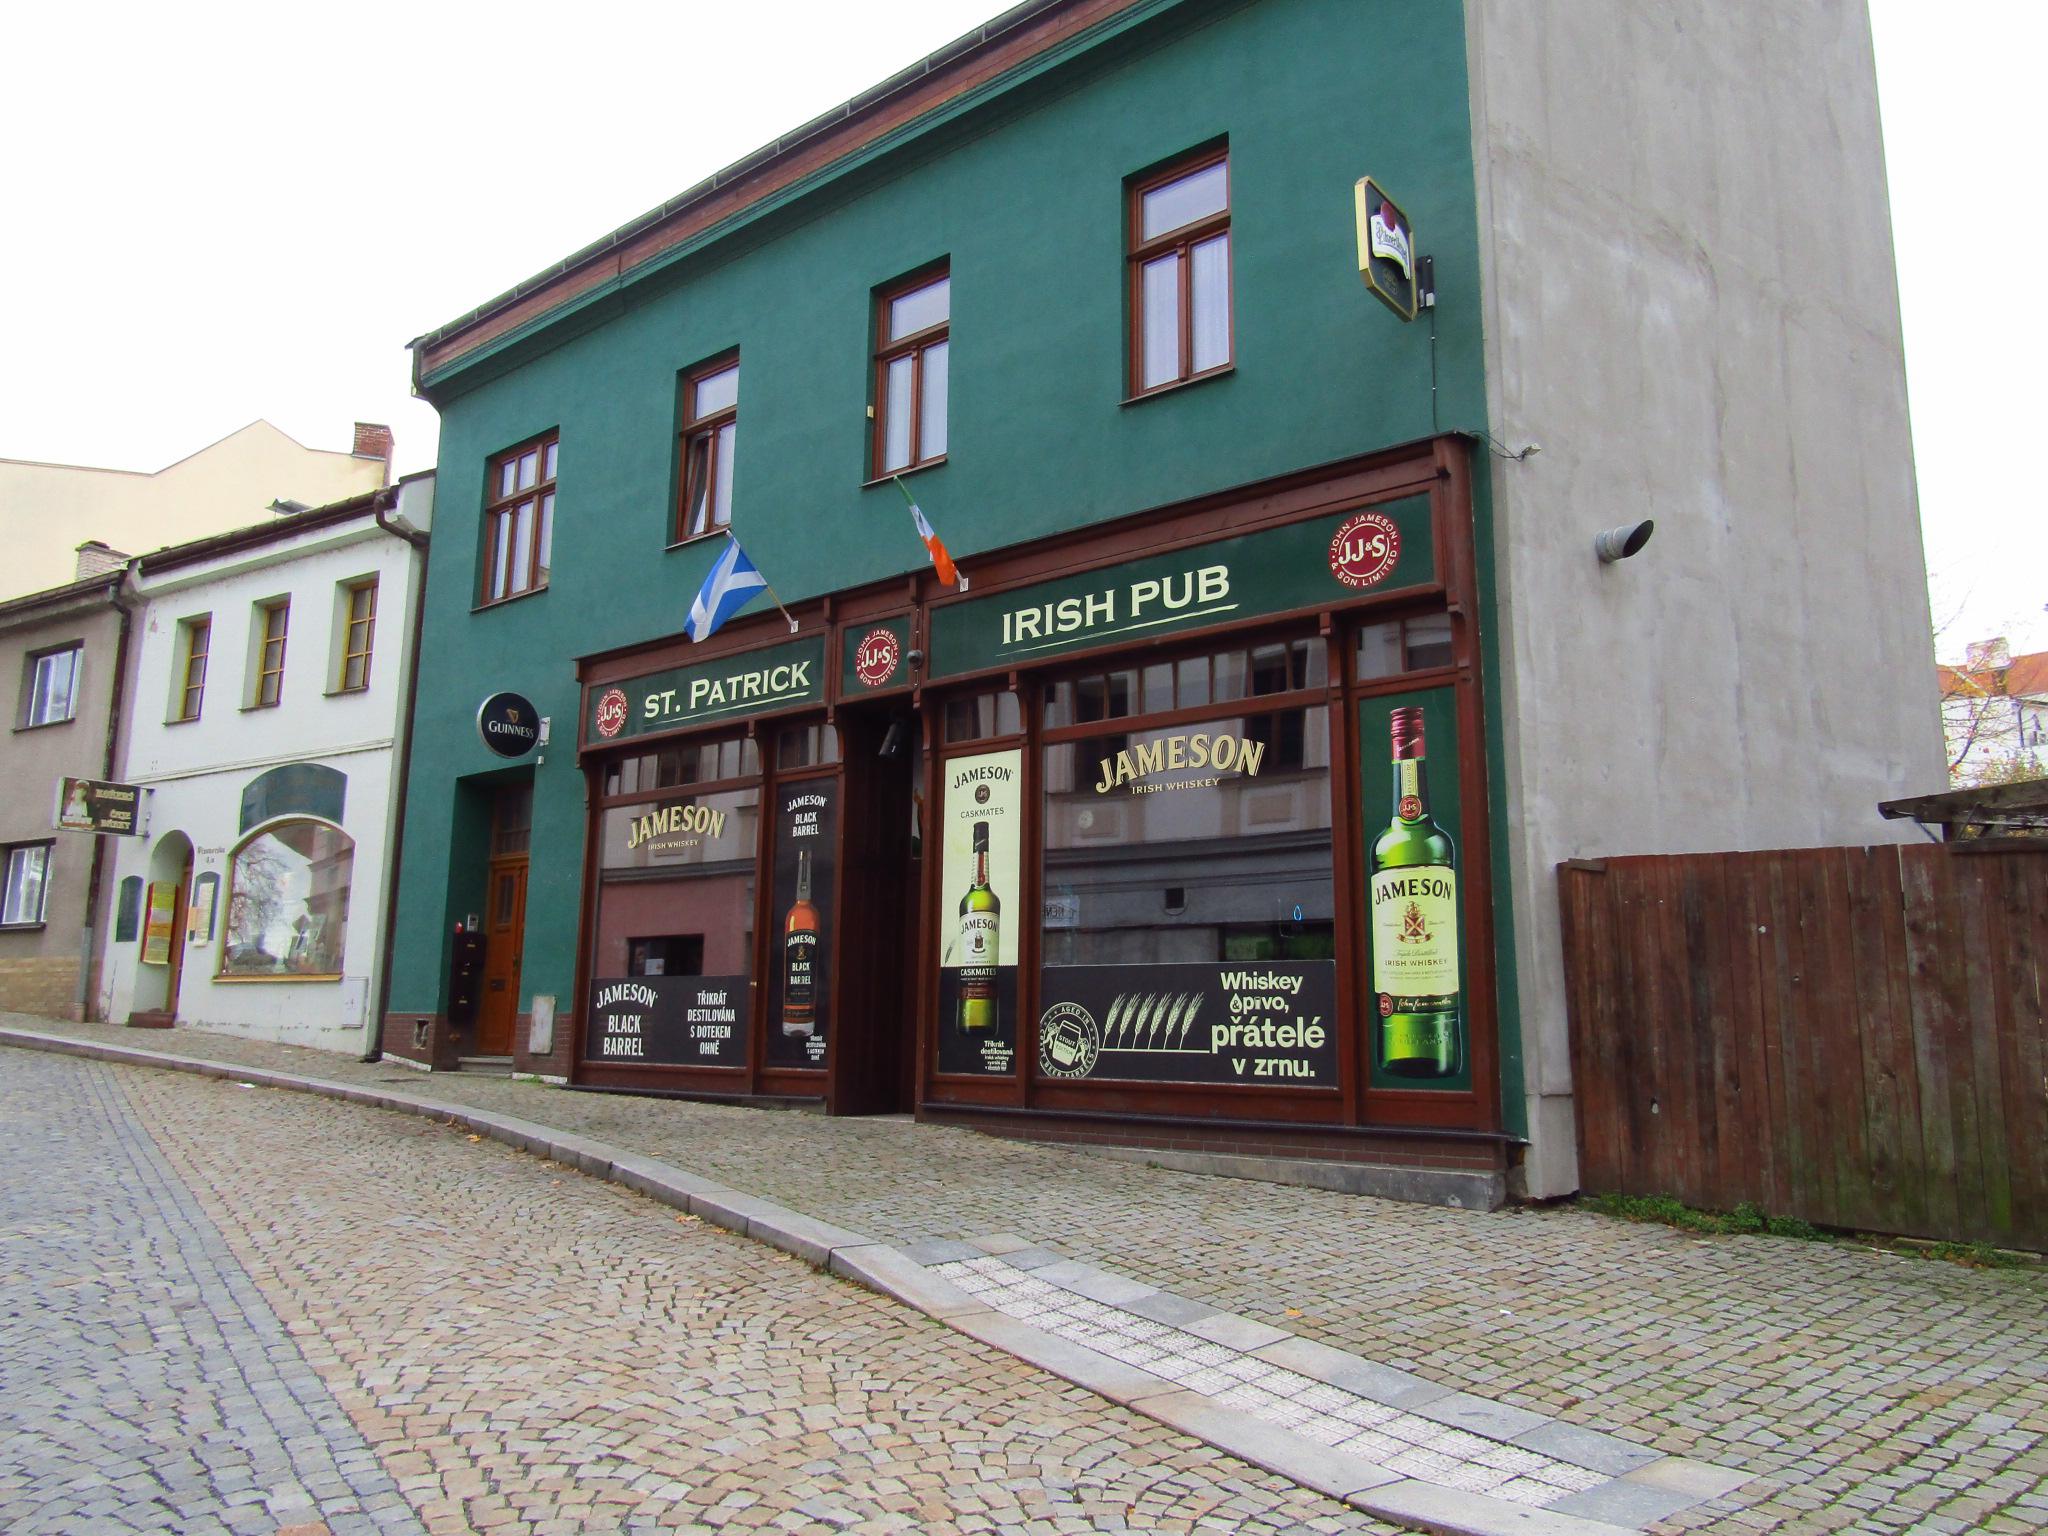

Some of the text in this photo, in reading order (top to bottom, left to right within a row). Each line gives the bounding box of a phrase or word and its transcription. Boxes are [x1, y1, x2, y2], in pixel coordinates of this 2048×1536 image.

[1331, 514, 1397, 553] JOHN JAMESON
[1337, 571, 1358, 586] SON
[1362, 550, 1397, 586] LIMITED
[1002, 565, 1230, 644] IRISH PUB
[872, 629, 899, 651] JAMESON
[874, 659, 897, 686] LIMITED
[644, 660, 811, 718] ST. PATRICK
[488, 720, 534, 738] GUINNESS
[1095, 733, 1265, 793] JAMESON
[954, 766, 1012, 789] JAMESON
[1132, 777, 1221, 795] IRISH WHISKEY
[787, 794, 827, 812] JAMESON
[795, 811, 817, 824] BLACK
[960, 807, 1005, 819] CASKMATES
[627, 805, 726, 849] JAMESON
[792, 824, 819, 837] BARREL
[667, 839, 699, 848] WHISKEY
[1375, 878, 1452, 905] JAMESON
[961, 918, 998, 934] JAMESON
[787, 934, 817, 947] JAMESON
[792, 962, 810, 971] BLACK
[1385, 958, 1448, 967] IRISH WHISKEY
[790, 976, 811, 985] BARREL
[960, 968, 997, 976] CASKMATES
[1220, 971, 1303, 994] Whiskey
[596, 983, 656, 1009] JAMESON
[697, 989, 728, 1005] TŘIKRÁT
[687, 1008, 736, 1022] DESTILOVÁNA
[1061, 1006, 1081, 1015] AGED
[608, 1014, 641, 1034] BLACK
[690, 1025, 731, 1039] S DOTEKEM
[1058, 1034, 1076, 1047] STOUT
[1212, 1015, 1325, 1054] přátelé
[603, 1037, 644, 1056] BARREL
[699, 1040, 720, 1055] OHNĚ
[1231, 1058, 1316, 1077] v zrnu.
